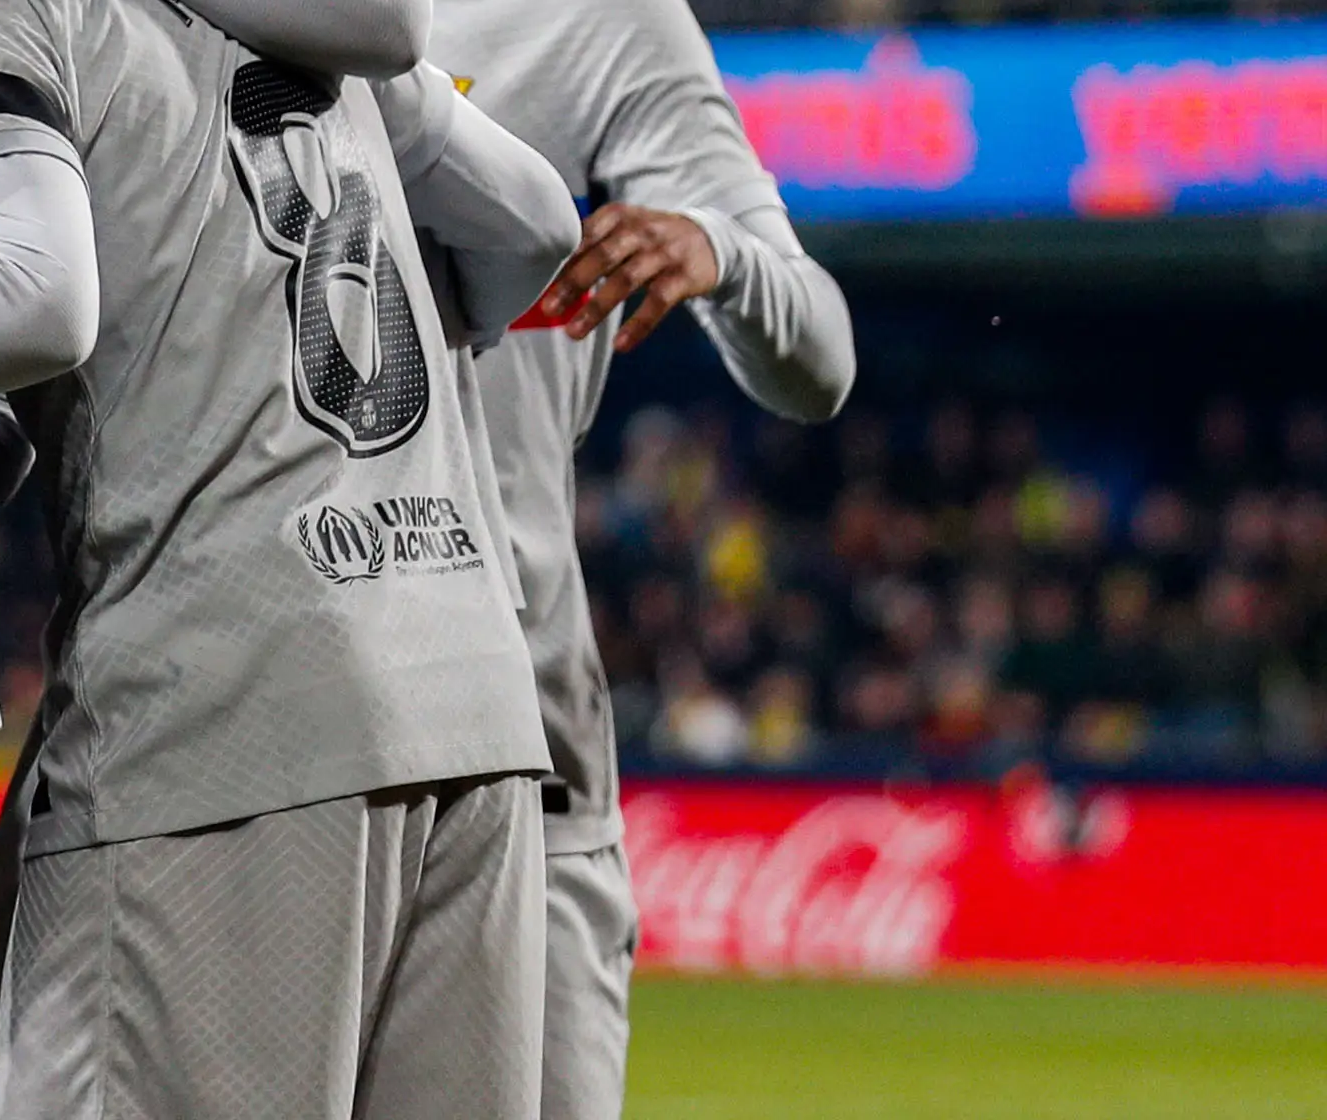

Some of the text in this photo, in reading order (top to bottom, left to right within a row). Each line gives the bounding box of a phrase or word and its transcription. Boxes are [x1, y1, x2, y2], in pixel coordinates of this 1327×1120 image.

[224, 59, 430, 459] 8
[373, 496, 463, 528] UNHCR
[393, 528, 479, 562] ACNUR
